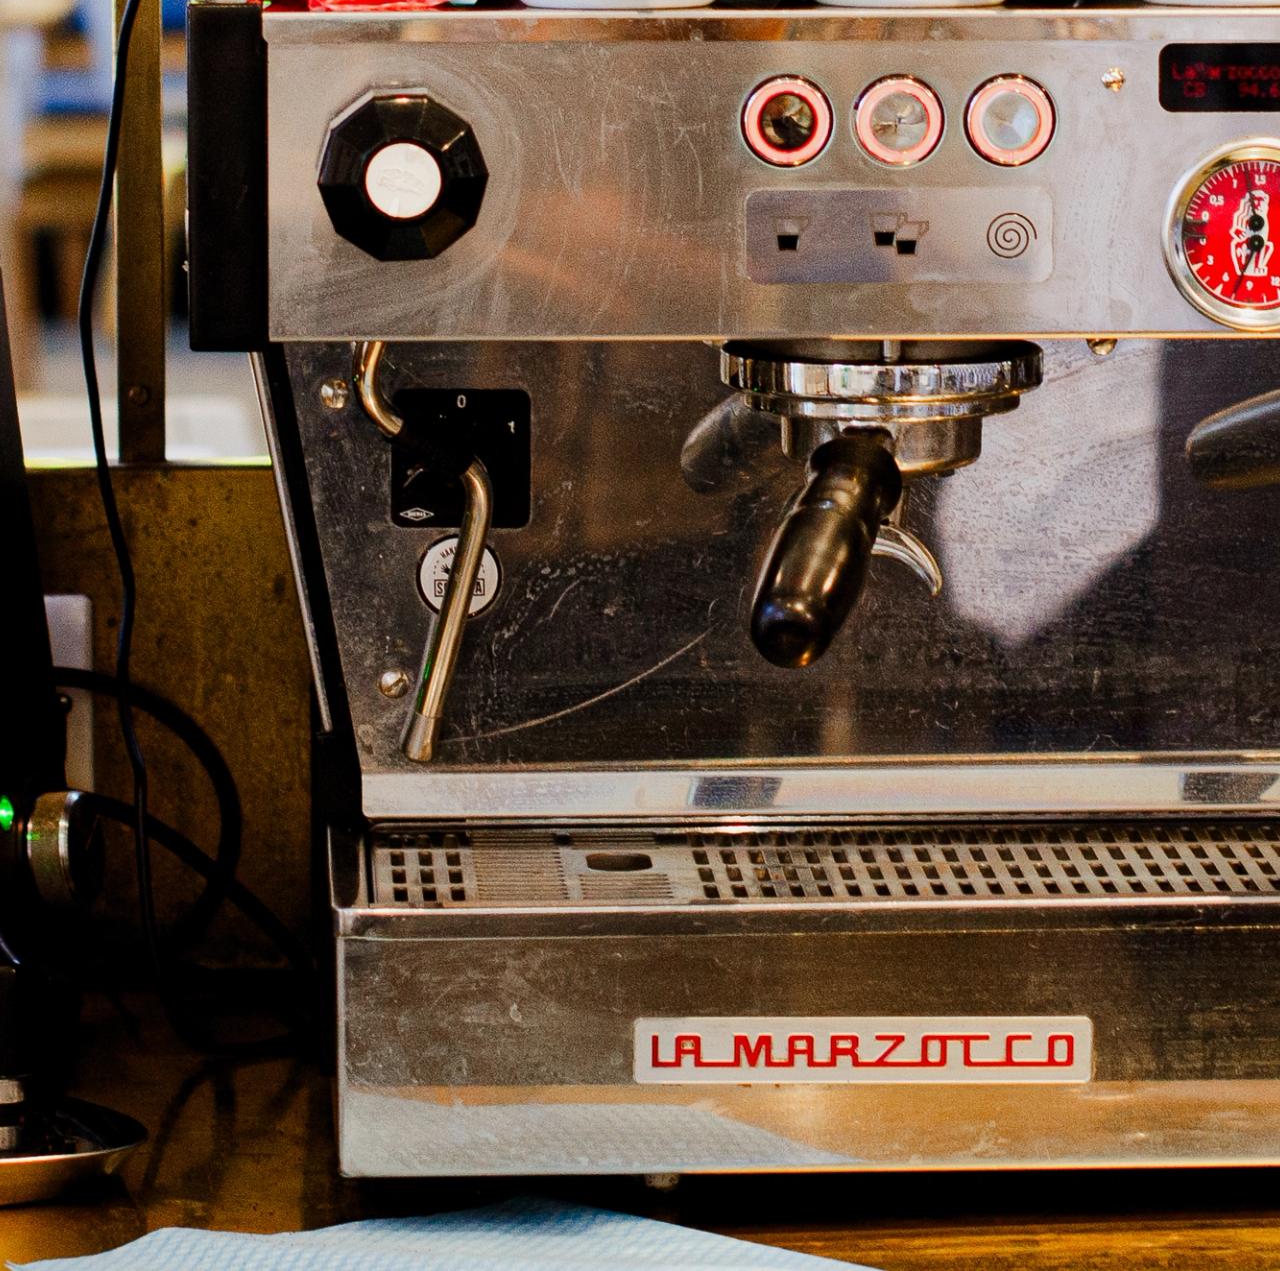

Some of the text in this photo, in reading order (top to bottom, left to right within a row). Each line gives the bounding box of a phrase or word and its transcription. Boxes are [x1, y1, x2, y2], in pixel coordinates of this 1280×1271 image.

[456, 394, 466, 408] 0
[507, 420, 516, 434] 1
[651, 1034, 1074, 1068] LA MARZOCCO
